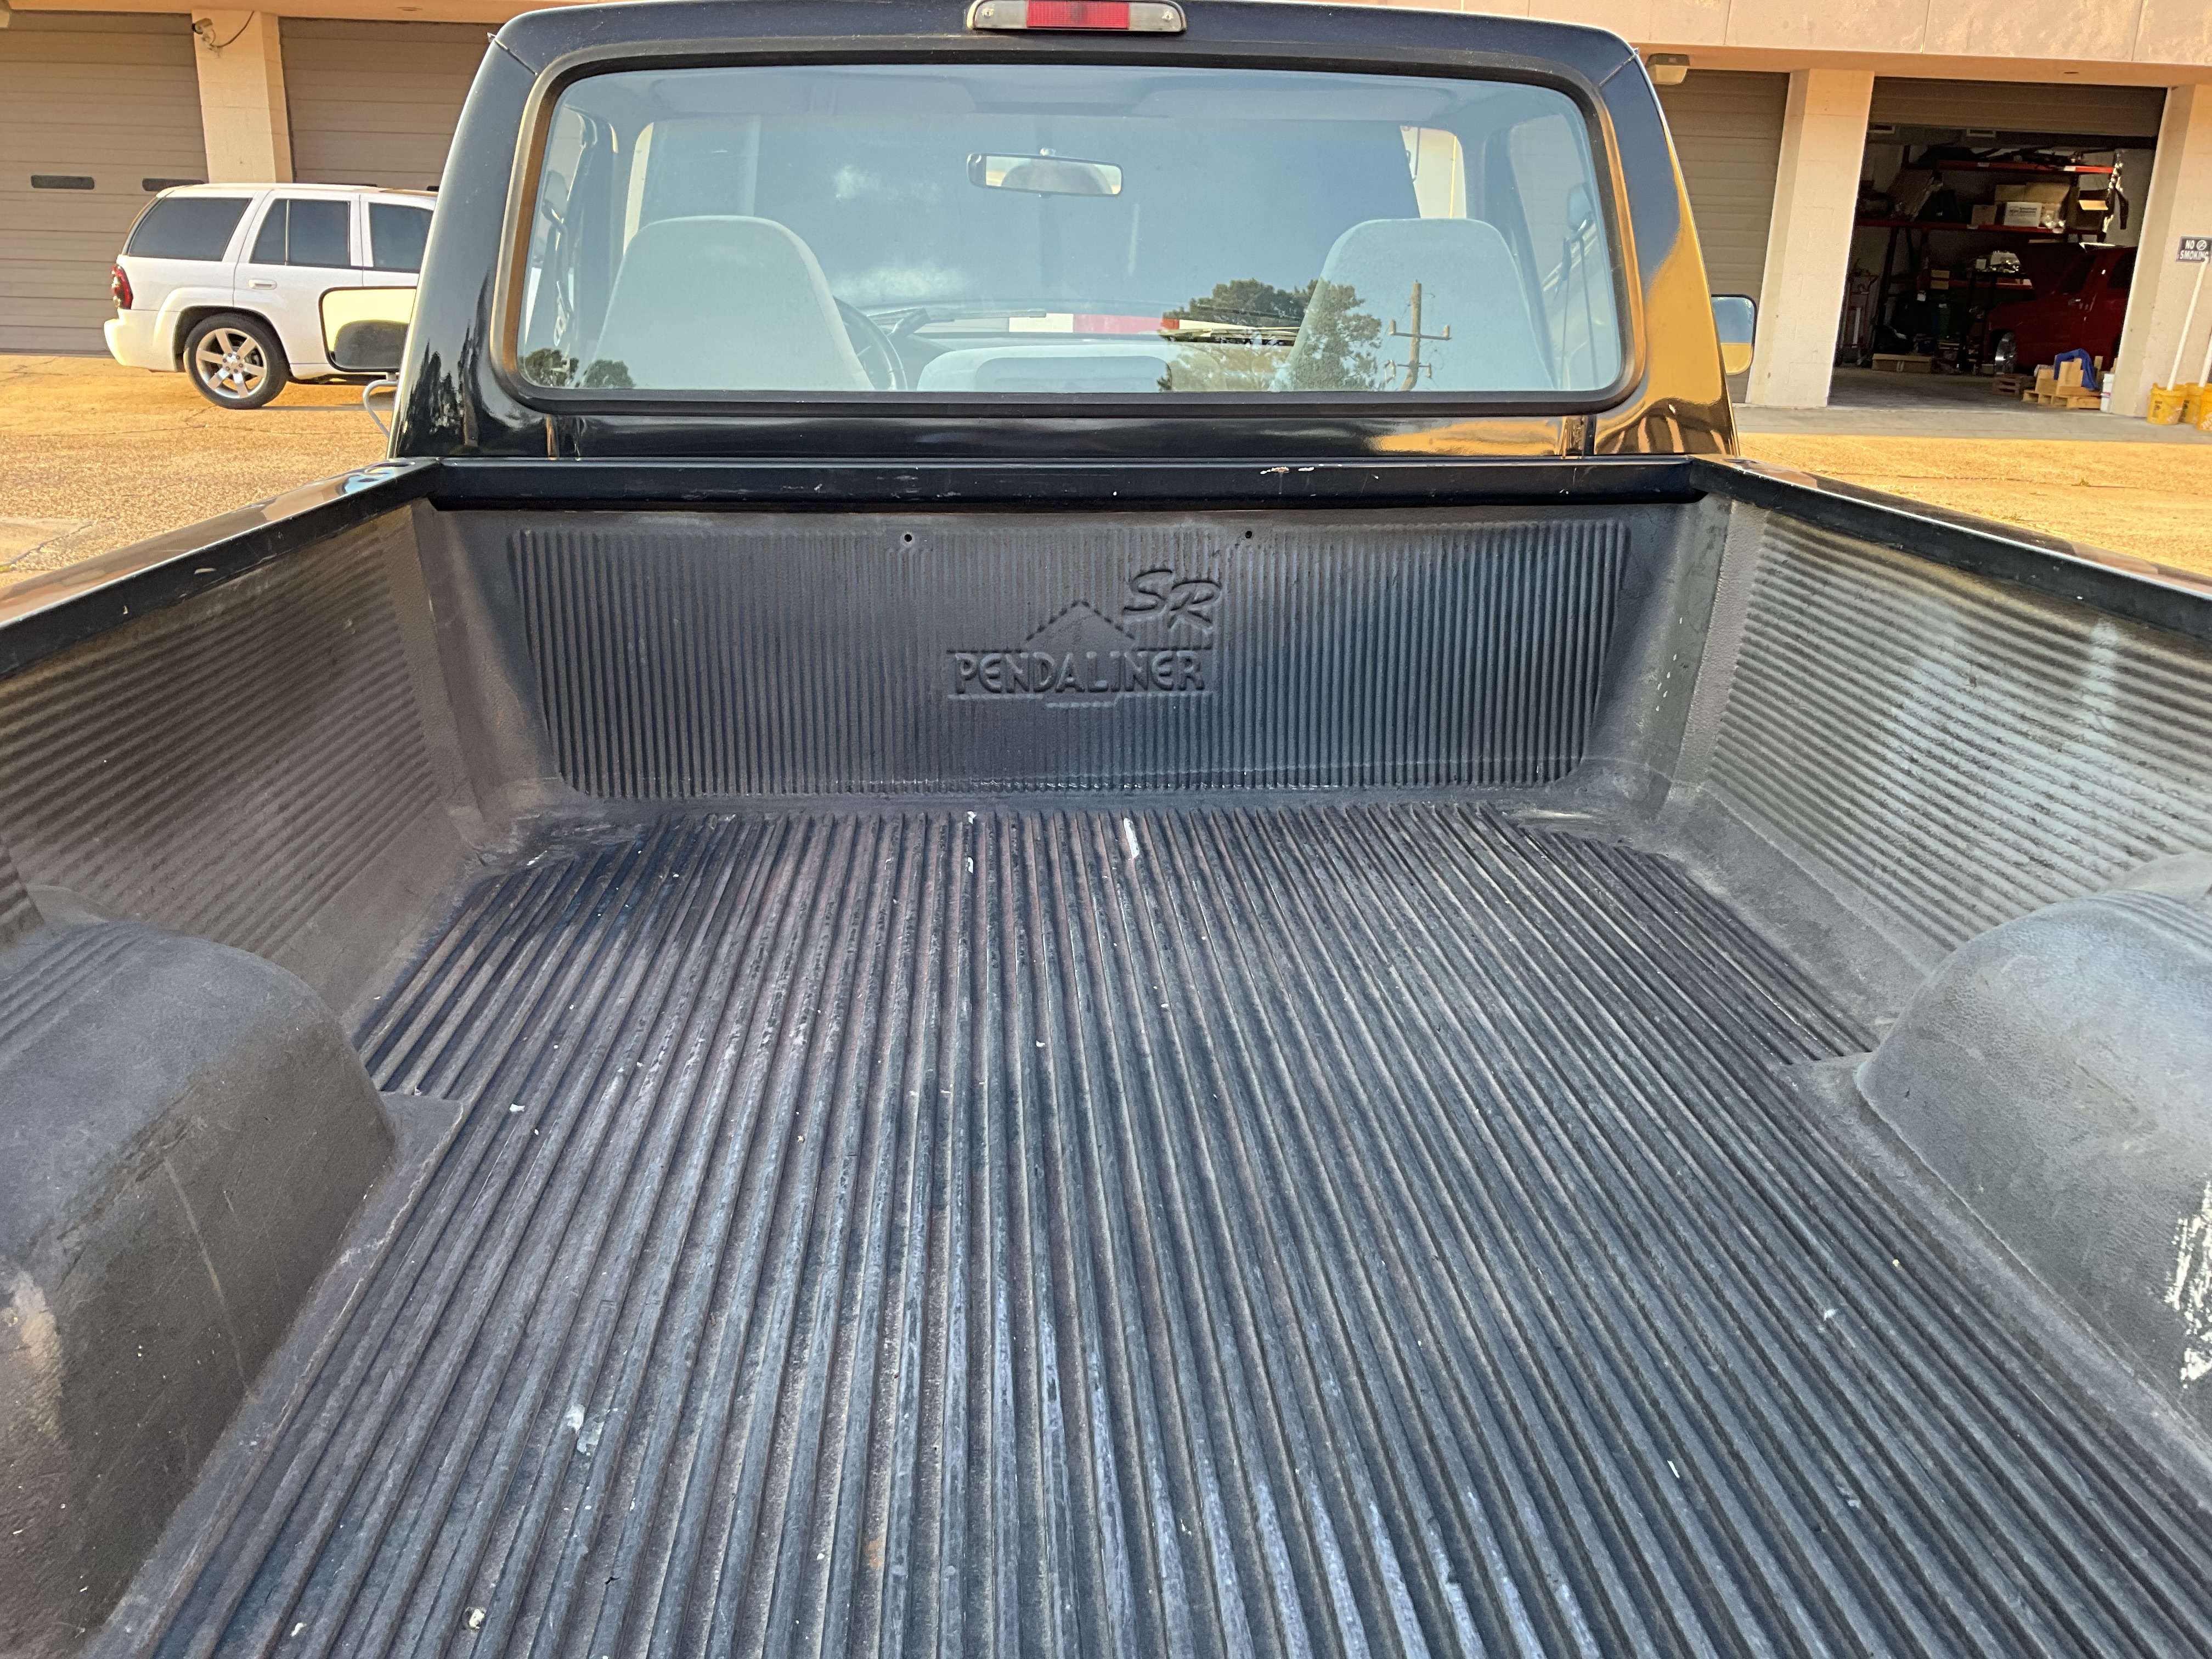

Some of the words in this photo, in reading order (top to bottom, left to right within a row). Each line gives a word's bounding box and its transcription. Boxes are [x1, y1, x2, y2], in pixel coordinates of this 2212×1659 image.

[2185, 240, 2195, 249] NO
[1122, 567, 1222, 634] SR
[953, 651, 1206, 693] PENDALINER
